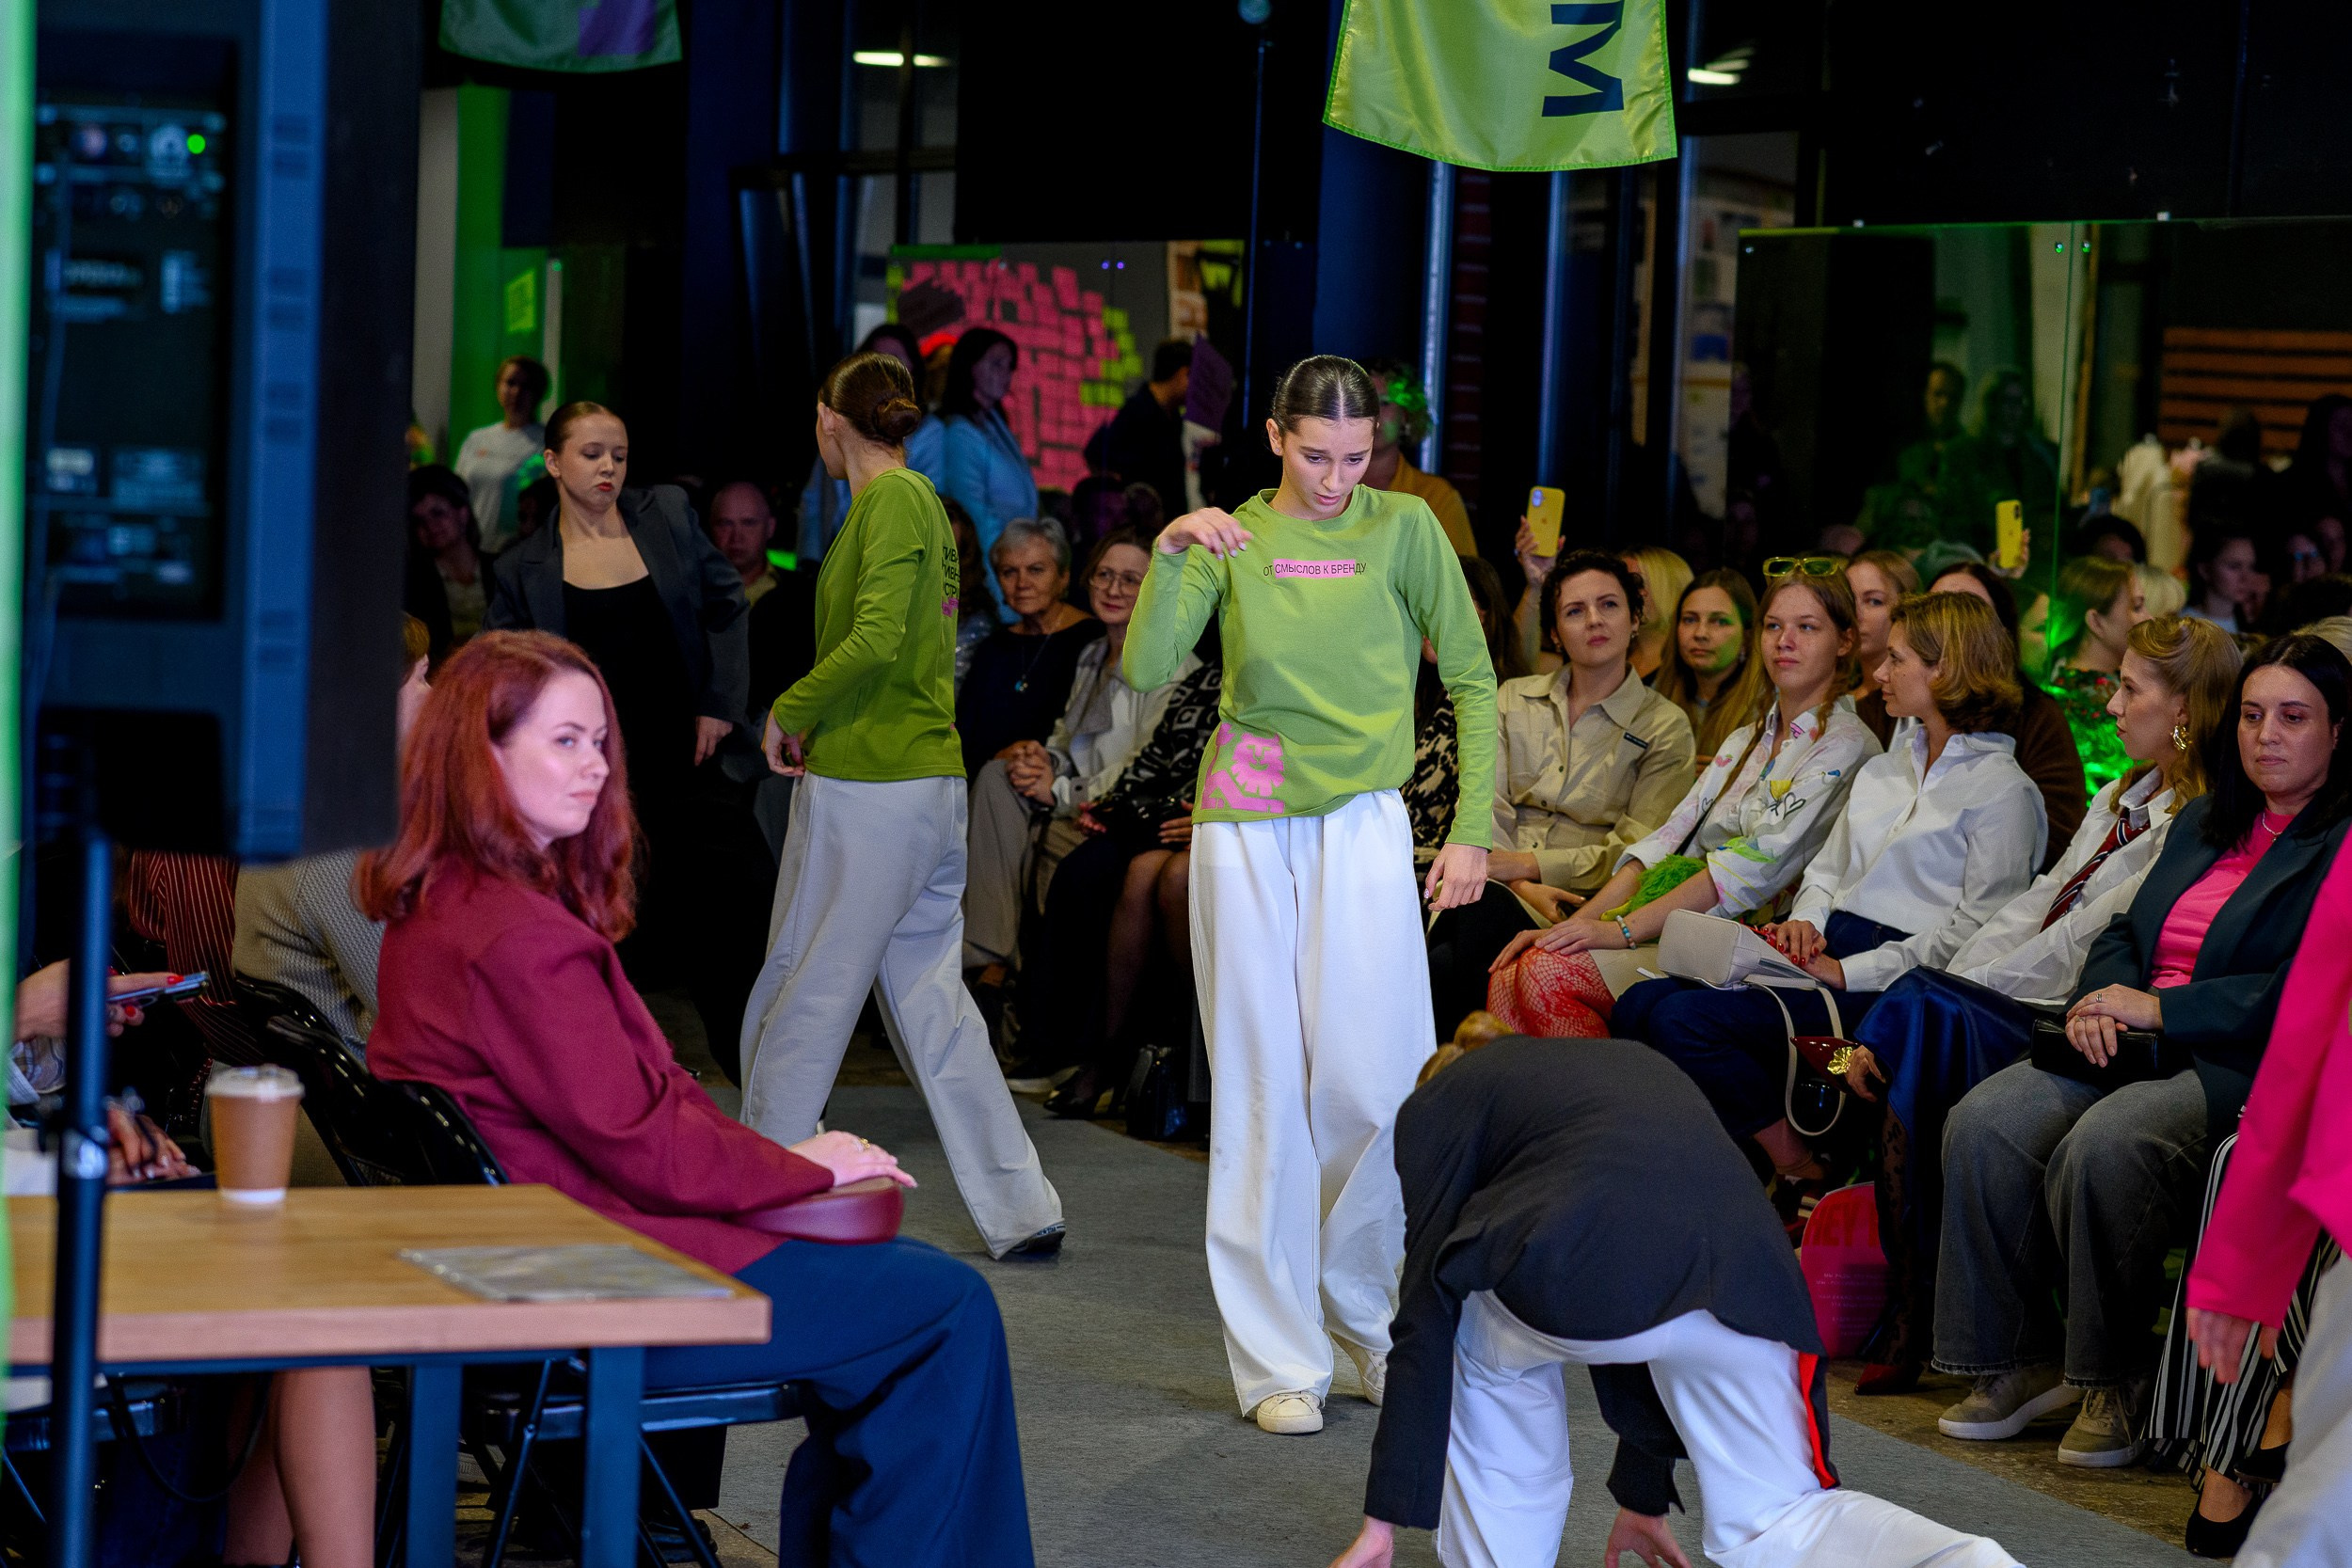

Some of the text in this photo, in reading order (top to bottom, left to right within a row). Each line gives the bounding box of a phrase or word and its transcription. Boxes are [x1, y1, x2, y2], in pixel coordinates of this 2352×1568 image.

[1263, 562, 1367, 577] ОТ СМЫСЛОВ К БРЕНДУ
